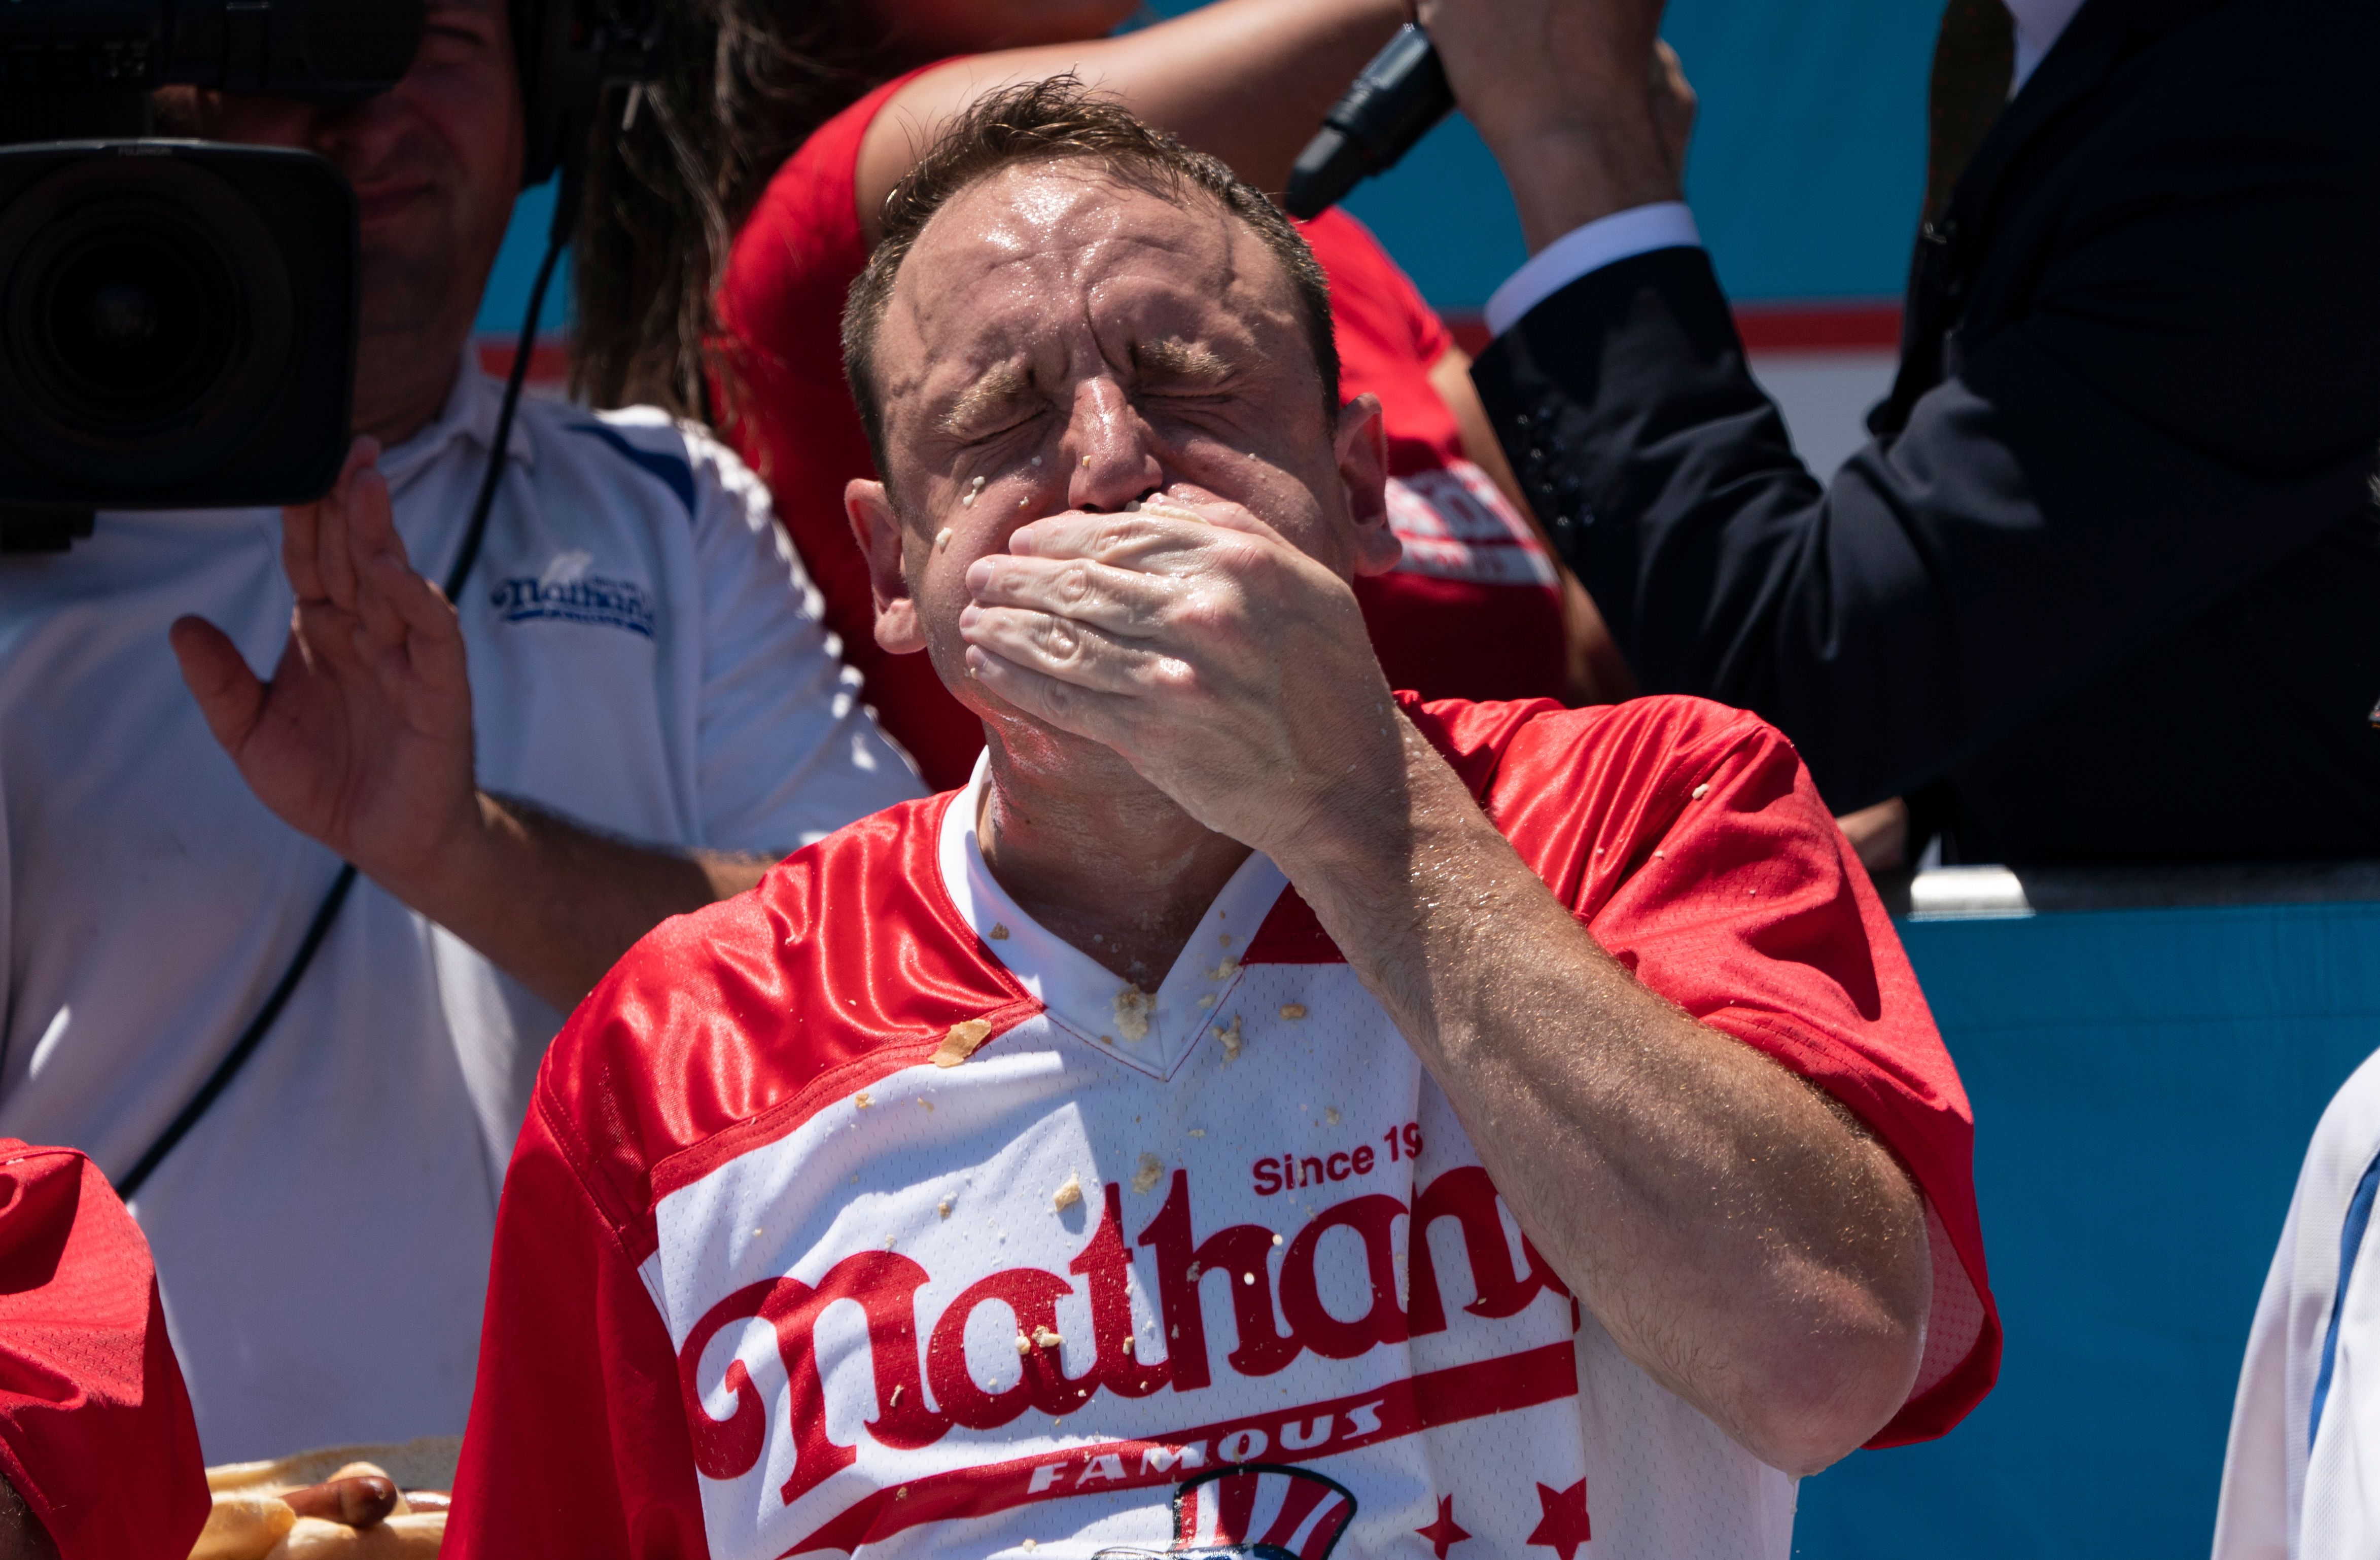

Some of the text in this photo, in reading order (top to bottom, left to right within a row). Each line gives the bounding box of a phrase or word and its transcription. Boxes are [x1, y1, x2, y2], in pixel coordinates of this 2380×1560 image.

[1252, 1145, 1374, 1196] Since
[678, 1166, 1581, 1505] Nathan
[1027, 1399, 1385, 1494] FAMOUS
